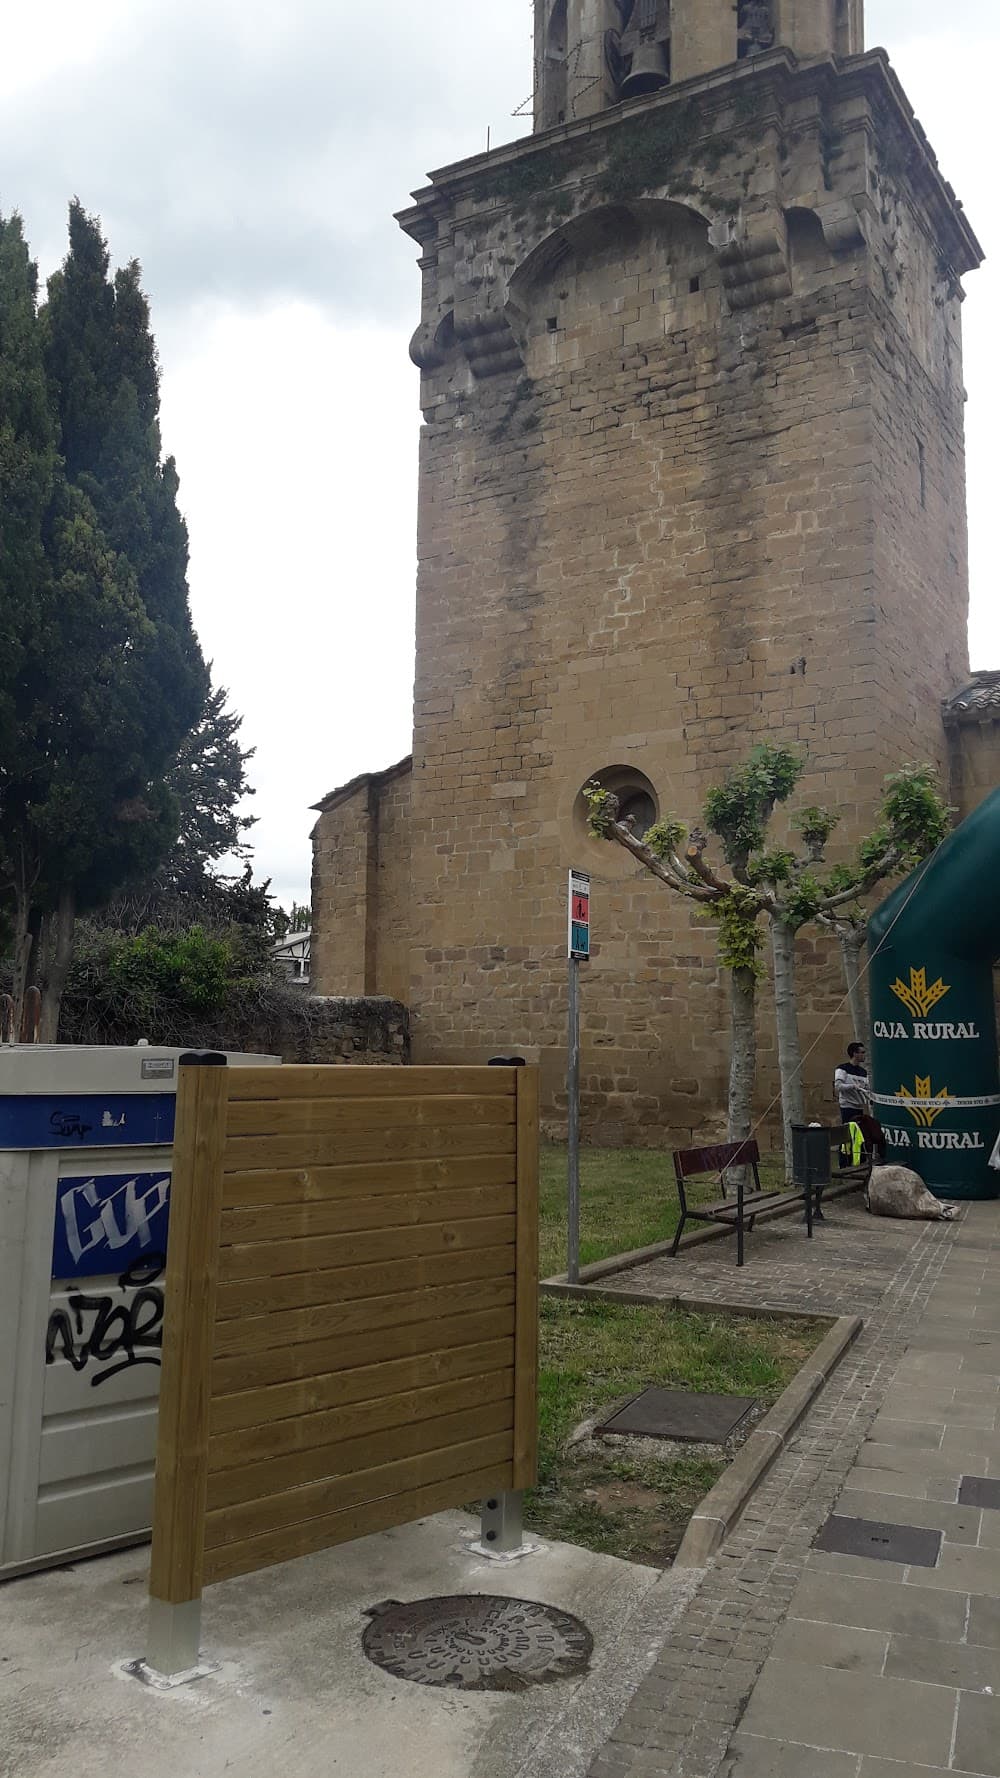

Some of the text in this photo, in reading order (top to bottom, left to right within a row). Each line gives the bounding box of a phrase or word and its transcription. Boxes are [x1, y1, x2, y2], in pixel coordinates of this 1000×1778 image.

[874, 1021, 980, 1039] CAJA RURAL
[917, 1131, 985, 1149] RURAL
